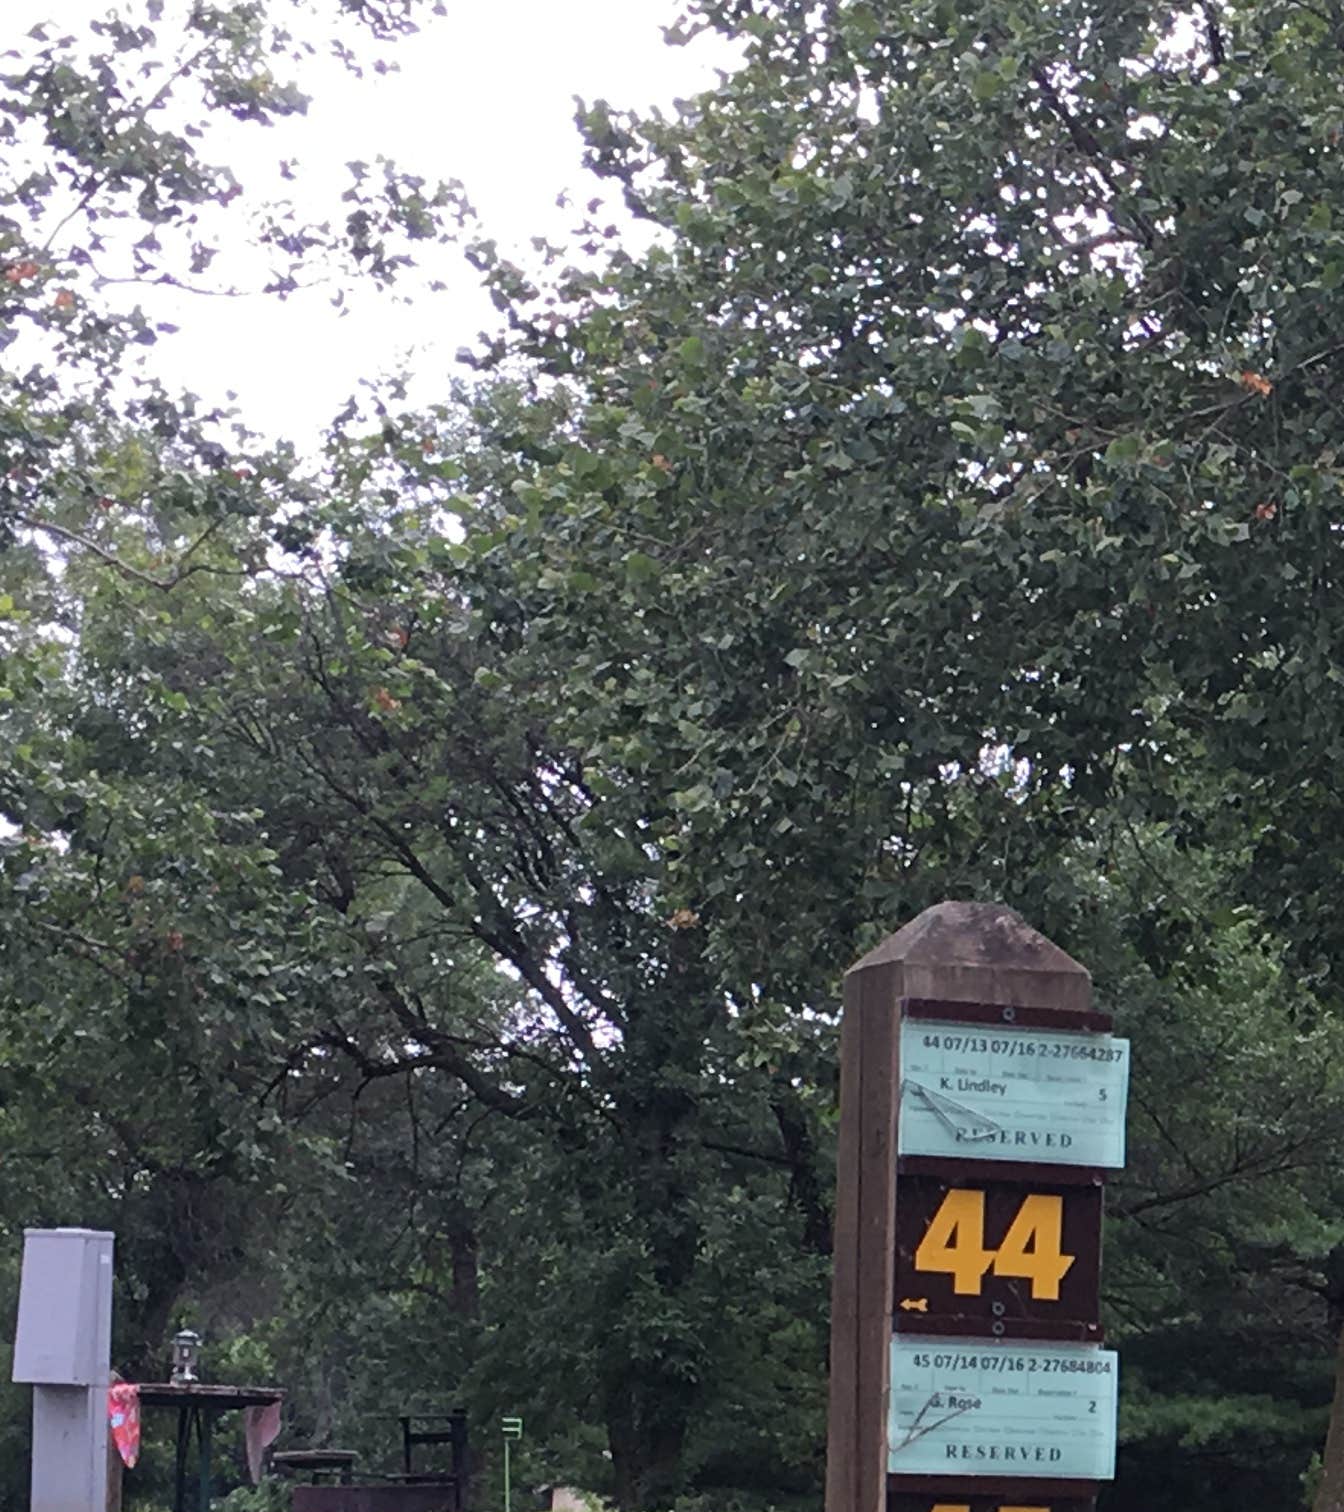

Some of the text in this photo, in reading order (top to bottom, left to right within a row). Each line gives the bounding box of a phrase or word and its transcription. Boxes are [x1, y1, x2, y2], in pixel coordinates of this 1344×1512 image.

[943, 1036, 987, 1054] 07/13
[991, 1040, 1036, 1057] 07/16
[955, 1127, 1073, 1149] RESERVED
[914, 1188, 1076, 1301] 44
[913, 1354, 931, 1369] 45
[934, 1354, 978, 1371] 07/14
[980, 1357, 1025, 1373] 07/16
[1088, 1400, 1097, 1414] 2
[945, 1443, 1063, 1462] RESERVED
